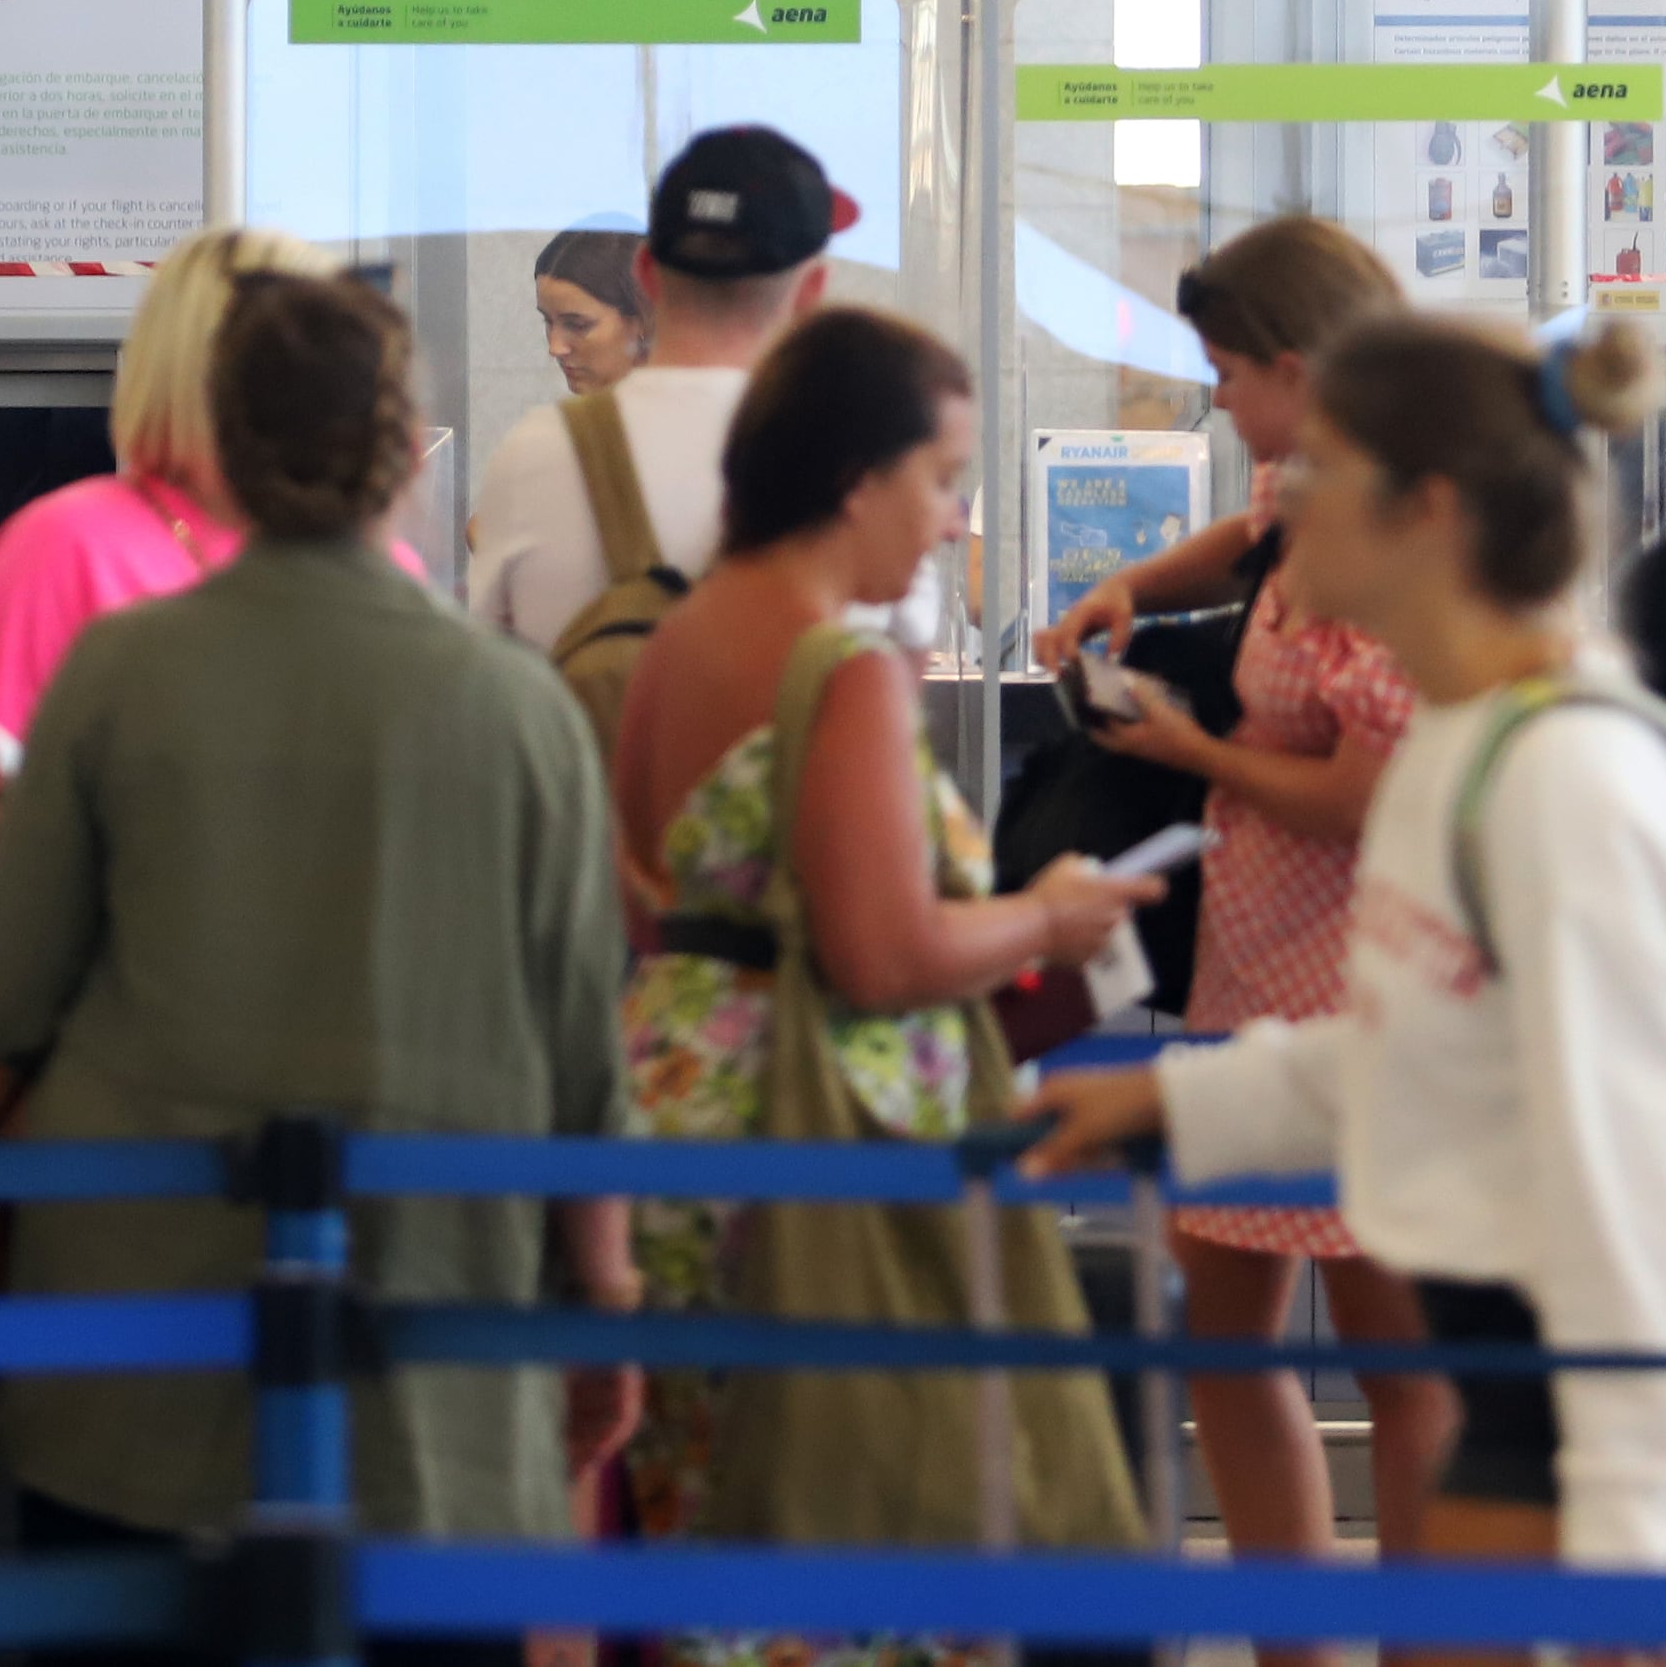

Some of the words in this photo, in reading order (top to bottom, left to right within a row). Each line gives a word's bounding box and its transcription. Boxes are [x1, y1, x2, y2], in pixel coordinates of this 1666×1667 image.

[772, 8, 826, 22] aena
[1573, 84, 1627, 98] aena
[1062, 446, 1128, 460] RYANAIR
